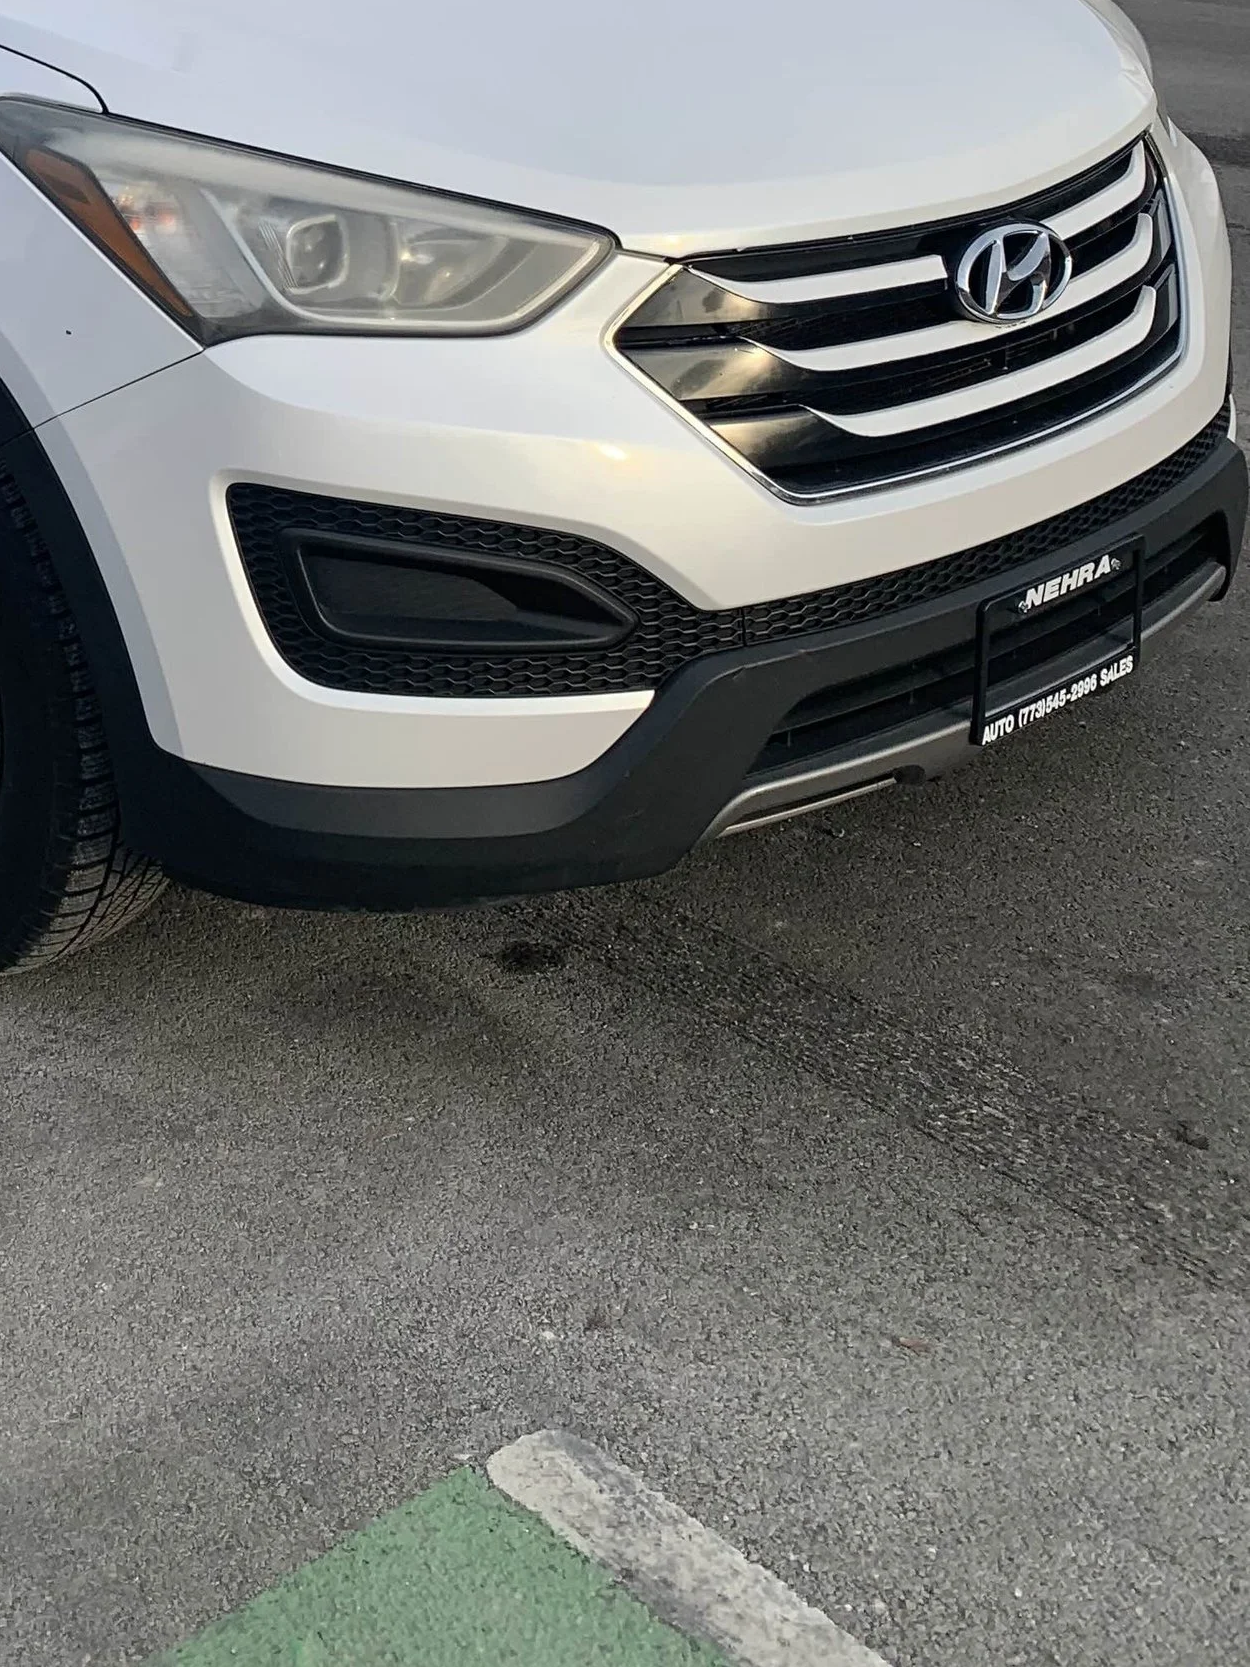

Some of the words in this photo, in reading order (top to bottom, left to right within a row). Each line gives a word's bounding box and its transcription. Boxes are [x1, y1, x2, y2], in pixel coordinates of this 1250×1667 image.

[1025, 554, 1111, 610] NEHRA
[982, 714, 1014, 746] AUTO
[1100, 655, 1133, 687] SALES
